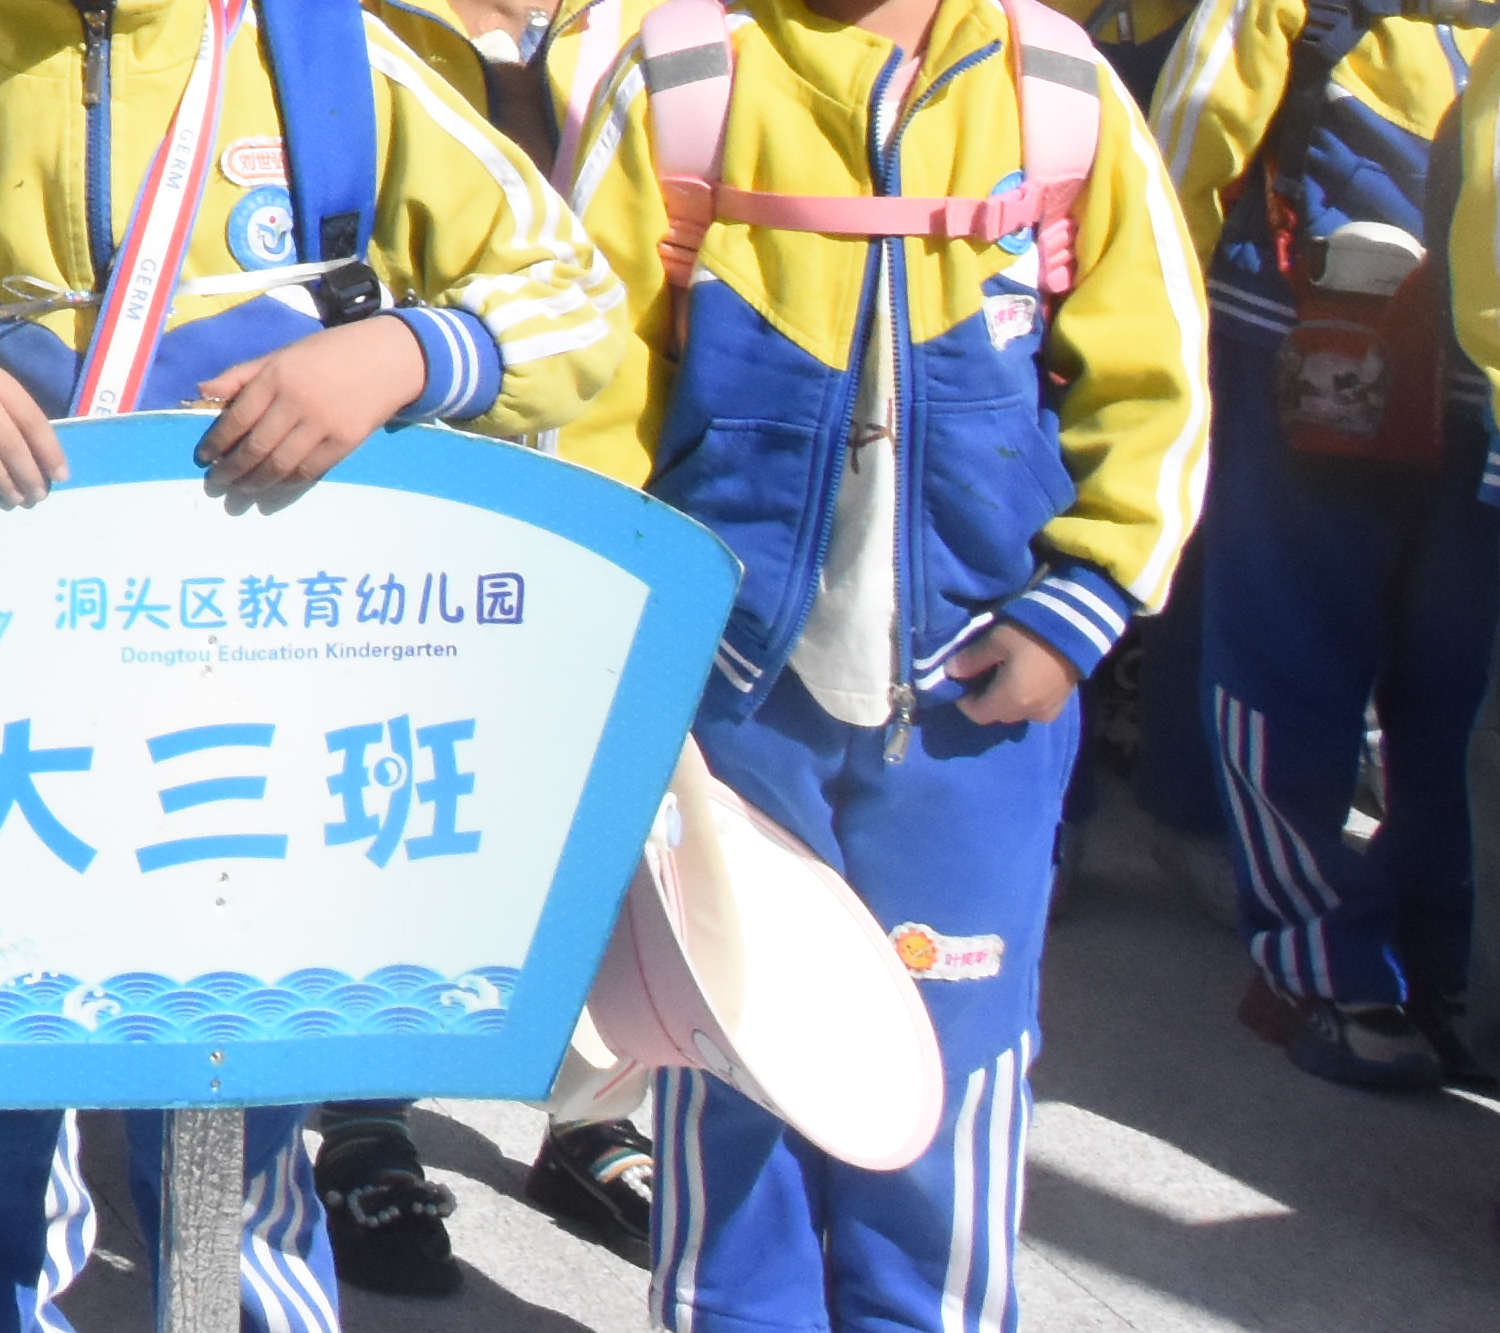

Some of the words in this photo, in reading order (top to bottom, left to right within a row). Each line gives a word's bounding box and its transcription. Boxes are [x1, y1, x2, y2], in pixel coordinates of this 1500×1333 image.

[165, 128, 195, 191] GERM
[124, 258, 157, 321] GERM
[55, 570, 525, 631] 洞头区教育幼儿园
[120, 645, 211, 667] Dongtou
[217, 643, 320, 663] Education
[326, 641, 458, 662] Kindergarten
